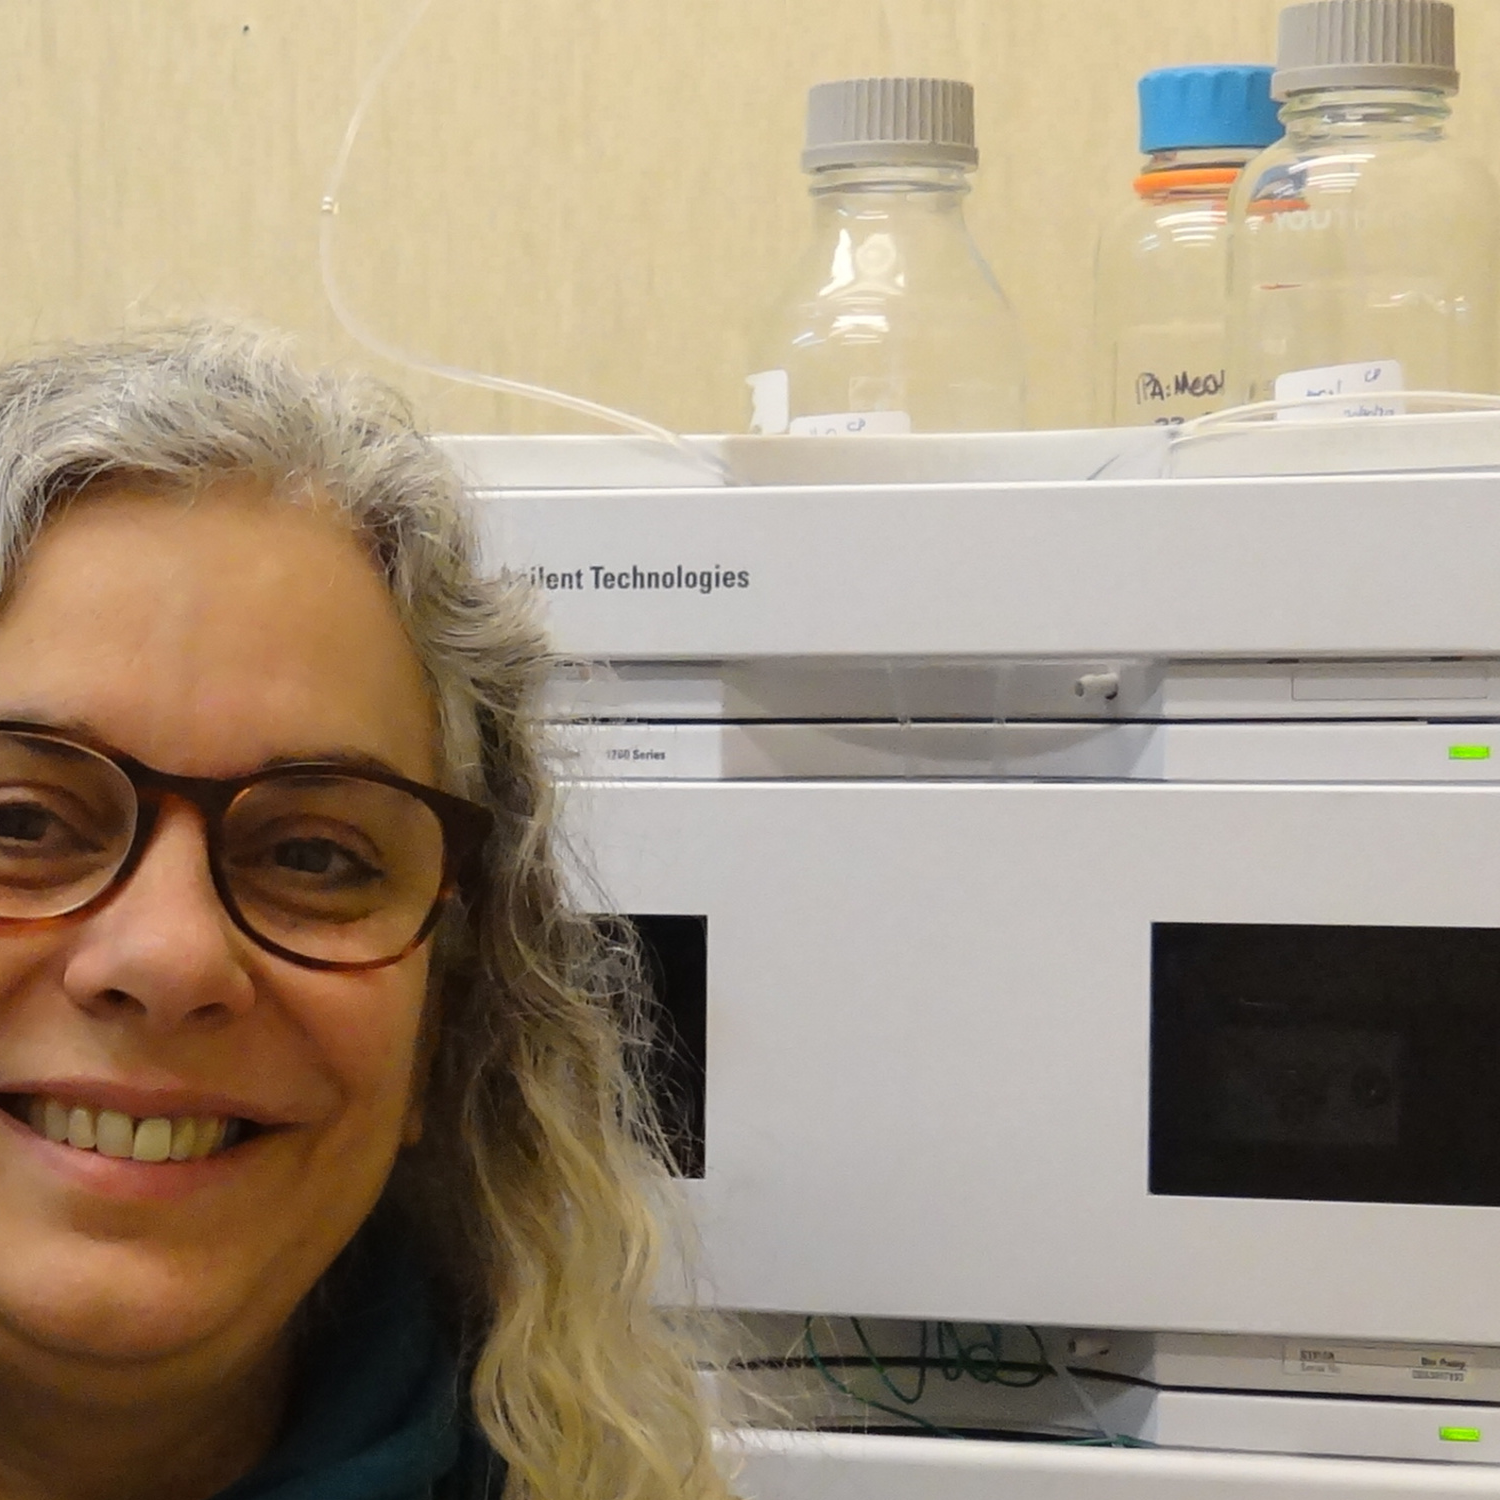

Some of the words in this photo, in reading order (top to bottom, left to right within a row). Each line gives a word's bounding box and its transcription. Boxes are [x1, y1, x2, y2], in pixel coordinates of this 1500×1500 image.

[501, 564, 584, 590] ilent
[590, 564, 750, 594] Technologies
[632, 748, 666, 760] Series
